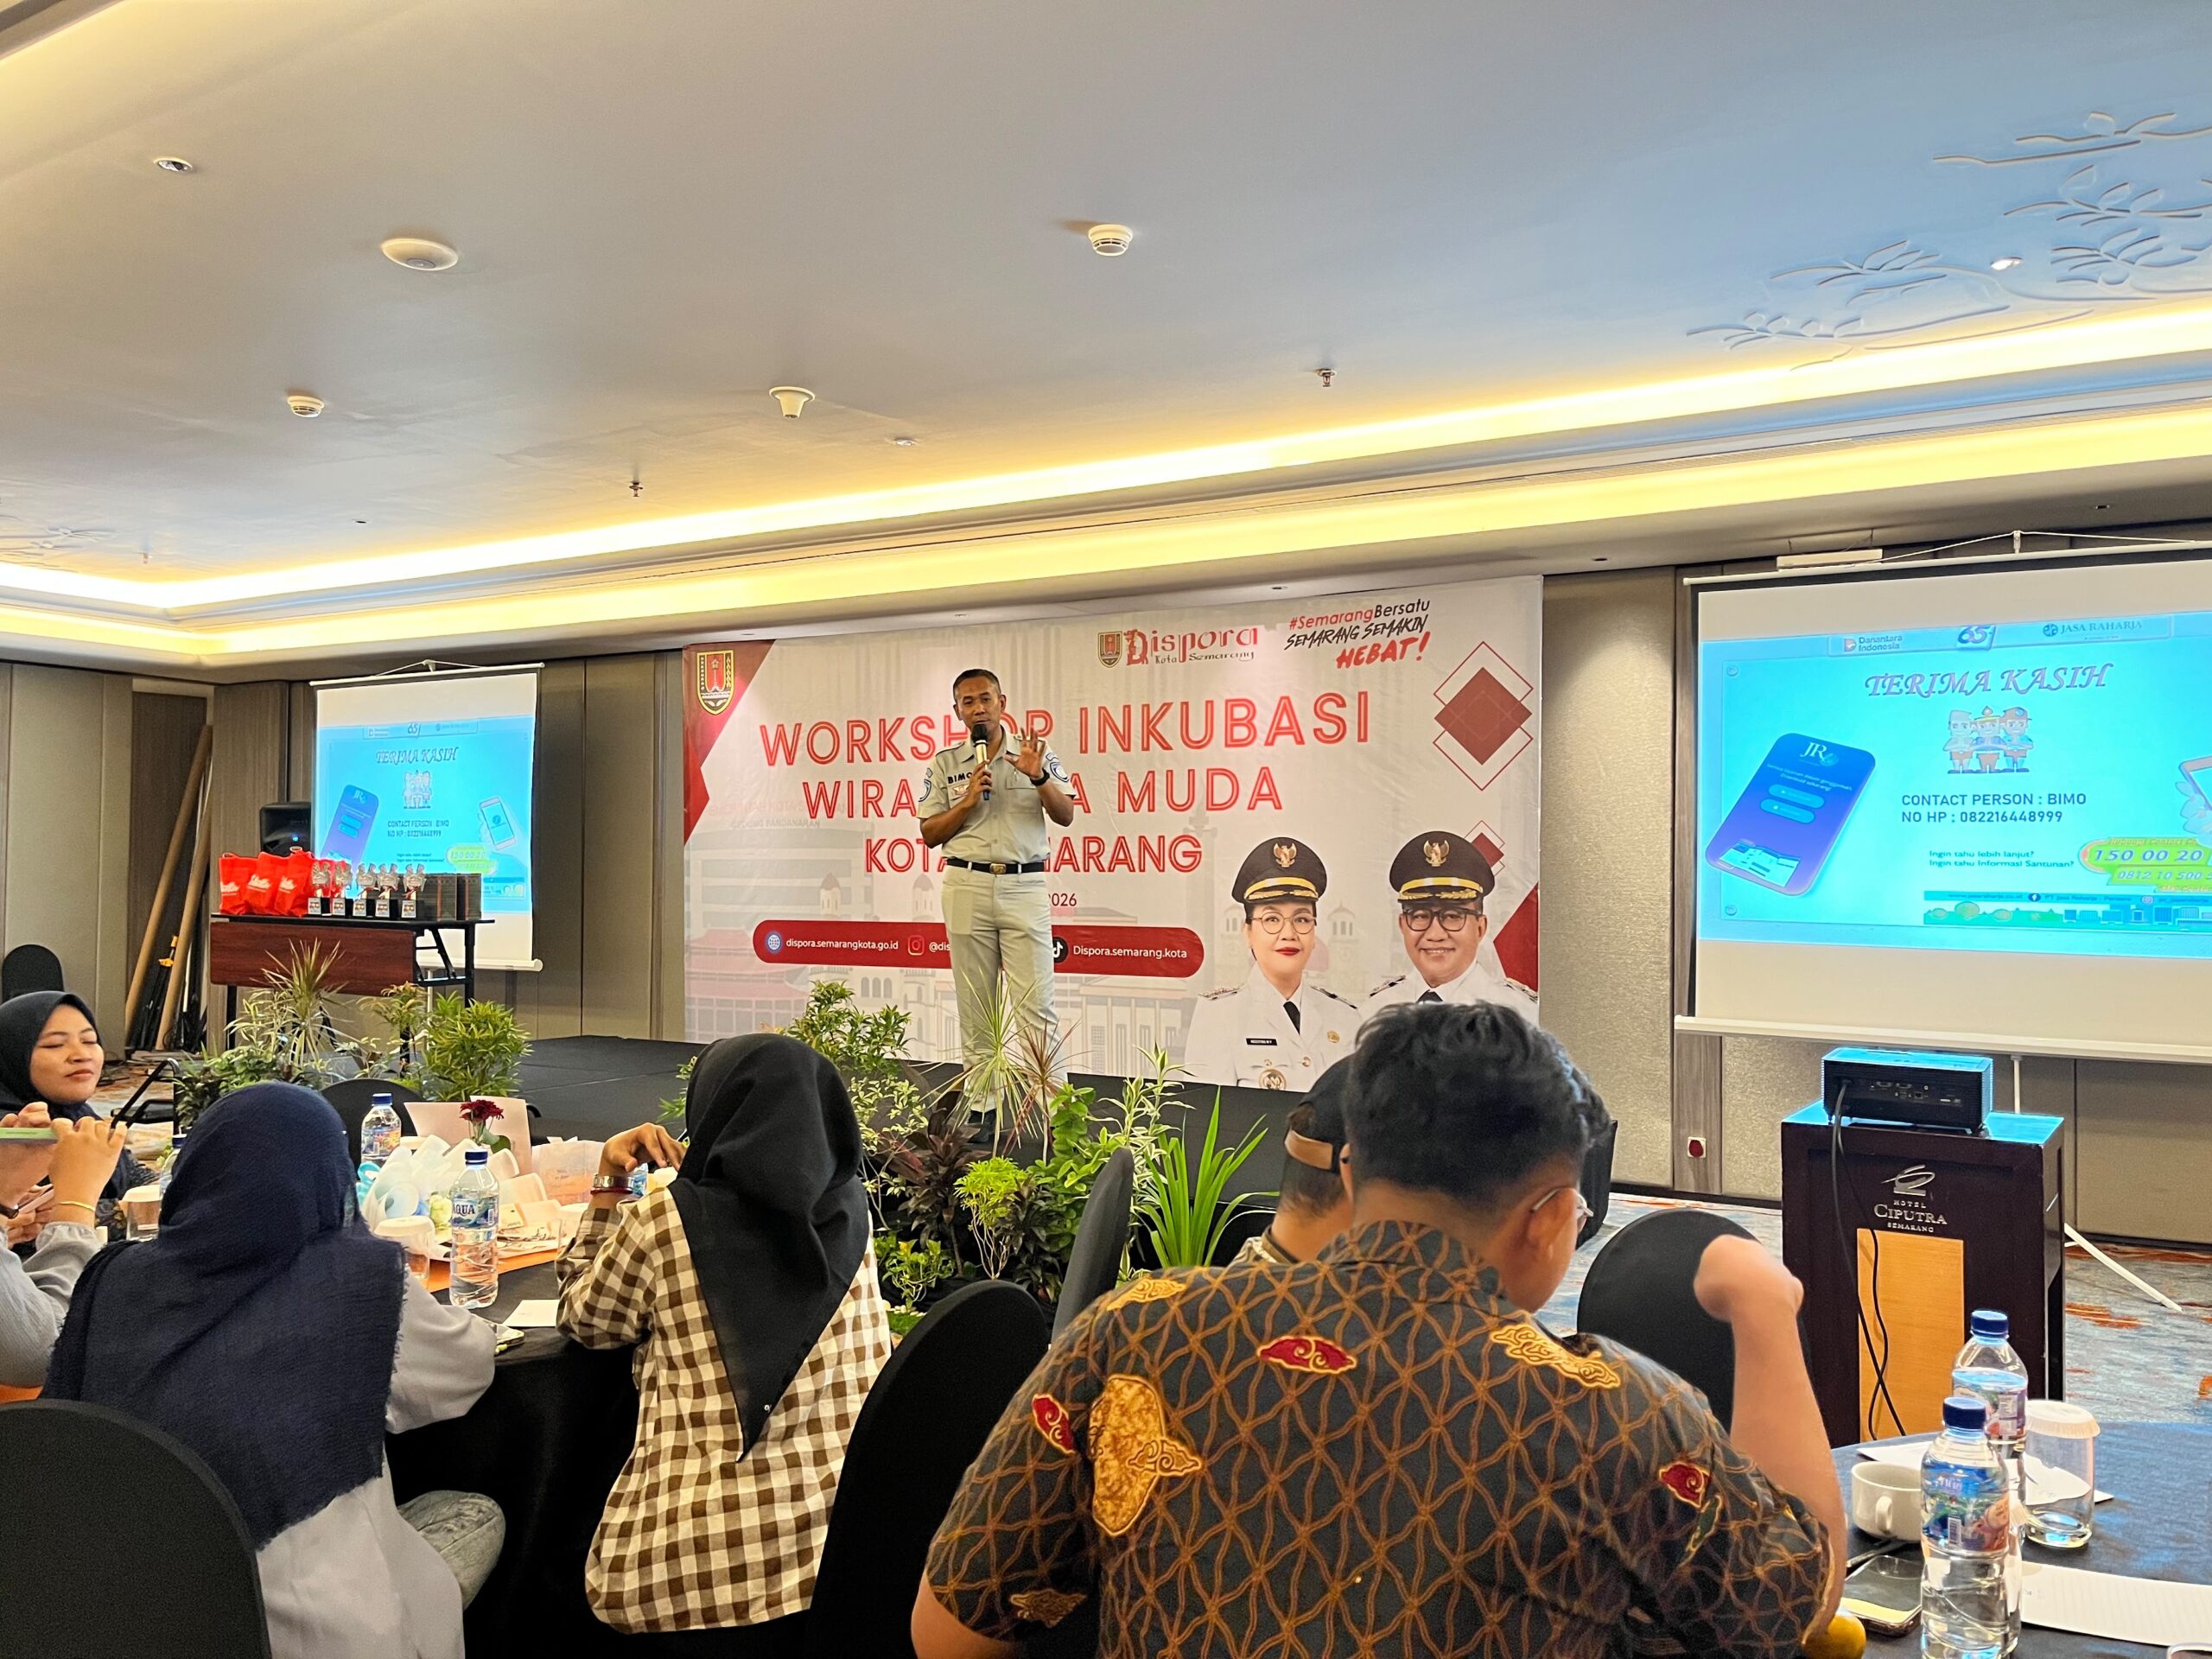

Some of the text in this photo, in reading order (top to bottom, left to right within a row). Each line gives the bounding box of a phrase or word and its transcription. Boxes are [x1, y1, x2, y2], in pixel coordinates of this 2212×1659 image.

[1289, 599, 1430, 630] #SemarangBersatu
[1284, 614, 1429, 650] SEMARANG SEMAKIN
[2061, 620, 2142, 634] JASA RAHARJA
[1859, 635, 1903, 644] Danantara
[1123, 627, 1258, 666] Dispora
[1336, 631, 1431, 669] HEBAT!
[1859, 643, 1900, 652] Indonesia
[1154, 652, 1255, 664] Kota Semarang
[1865, 663, 2114, 698] TERIMA KASIH
[1079, 691, 1369, 753] INKUBASI
[376, 747, 459, 766] TERIMA KASIH
[1117, 766, 1283, 813] MUDA
[1901, 794, 1967, 806] CONTACT
[1972, 793, 2033, 805] PERSON
[2047, 793, 2087, 805] BIMO
[1902, 811, 1922, 823] NO
[1927, 811, 1948, 823] HP
[1960, 810, 2063, 823] 082216448999
[865, 837, 947, 874] KOT
[1929, 850, 1952, 859] Ingin
[2004, 850, 2035, 859] lanjut?
[2094, 849, 2203, 861] 150 00 20
[1929, 860, 1952, 868] Ingin
[1048, 893, 1077, 906] 026
[785, 938, 899, 951] dispora.semarangkota.go.id
[1073, 945, 1187, 960] Dispora.semarang.kota
[1893, 1199, 1927, 1209] HOTEL
[1873, 1204, 1948, 1225] CIPUTRA
[1887, 1222, 1935, 1233] SEMARANG
